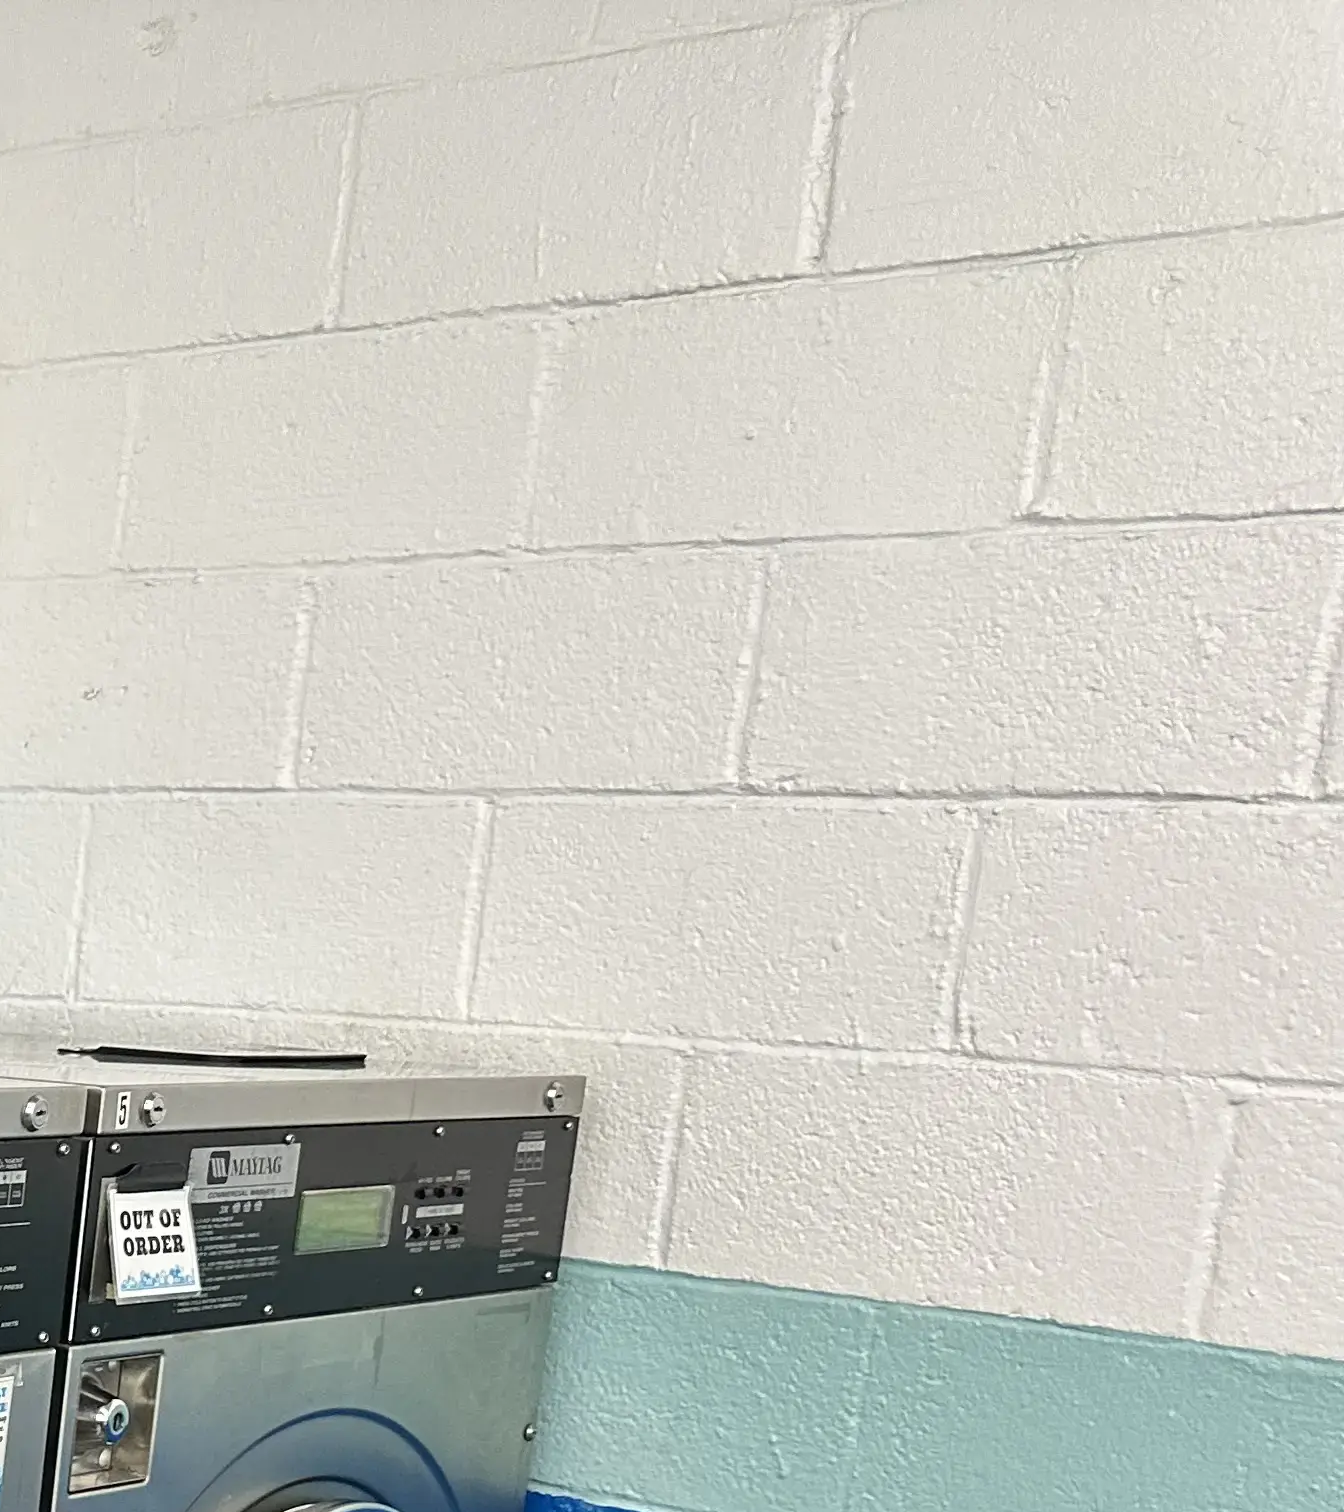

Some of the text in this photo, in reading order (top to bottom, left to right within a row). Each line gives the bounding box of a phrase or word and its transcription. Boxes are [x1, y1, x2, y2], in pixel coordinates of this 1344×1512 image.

[119, 1096, 127, 1125] 5
[230, 1156, 282, 1176] MAYTAG
[120, 1209, 181, 1230] OUT OF
[123, 1235, 185, 1256] ORDER
